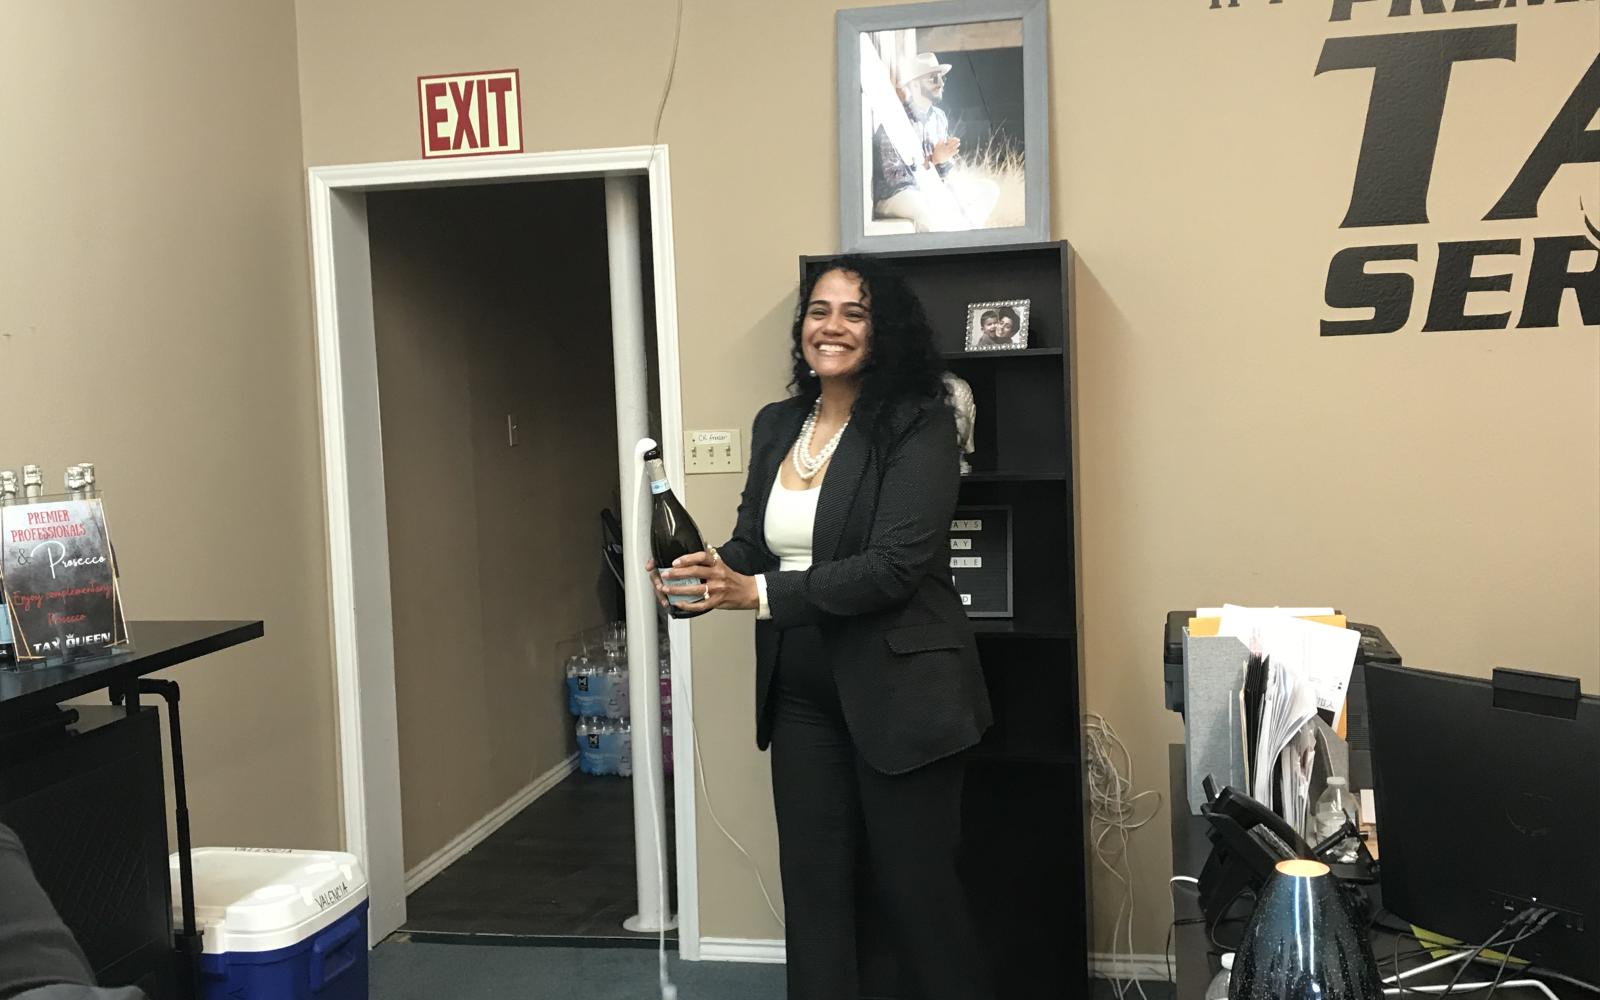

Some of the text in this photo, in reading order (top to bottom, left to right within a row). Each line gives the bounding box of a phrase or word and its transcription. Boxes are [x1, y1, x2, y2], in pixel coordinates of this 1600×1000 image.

[425, 77, 512, 152] EXIT
[1320, 236, 1600, 336] SER
[11, 523, 87, 542] PROFESSIONALS
[27, 510, 70, 525] PREMIER
[30, 541, 106, 579] Prosecco
[65, 632, 111, 648] QUEEN
[314, 881, 348, 911] VALENCIA
